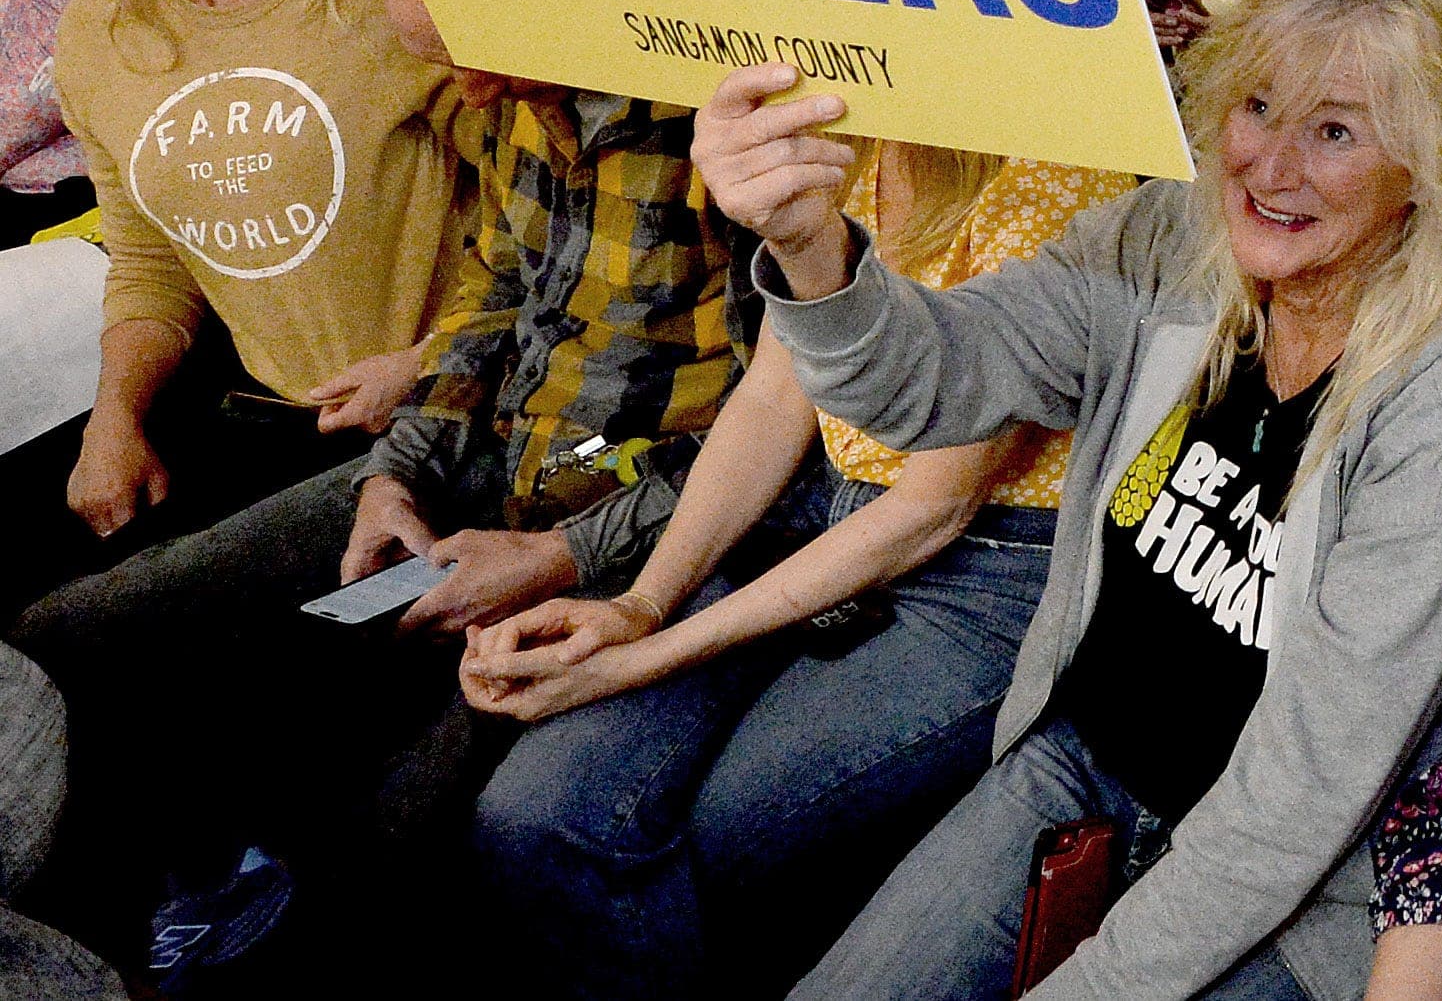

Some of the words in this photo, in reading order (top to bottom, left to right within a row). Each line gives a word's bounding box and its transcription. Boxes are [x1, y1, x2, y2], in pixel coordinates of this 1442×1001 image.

[624, 12, 768, 68] SANGAMON
[774, 35, 893, 88] COUNTY
[155, 101, 307, 156] FARM
[187, 162, 213, 181] TO
[226, 153, 273, 177] FEED
[213, 177, 250, 195] THE
[173, 203, 316, 251] WORLD
[1171, 441, 1241, 507] BE
[1229, 484, 1261, 531] A
